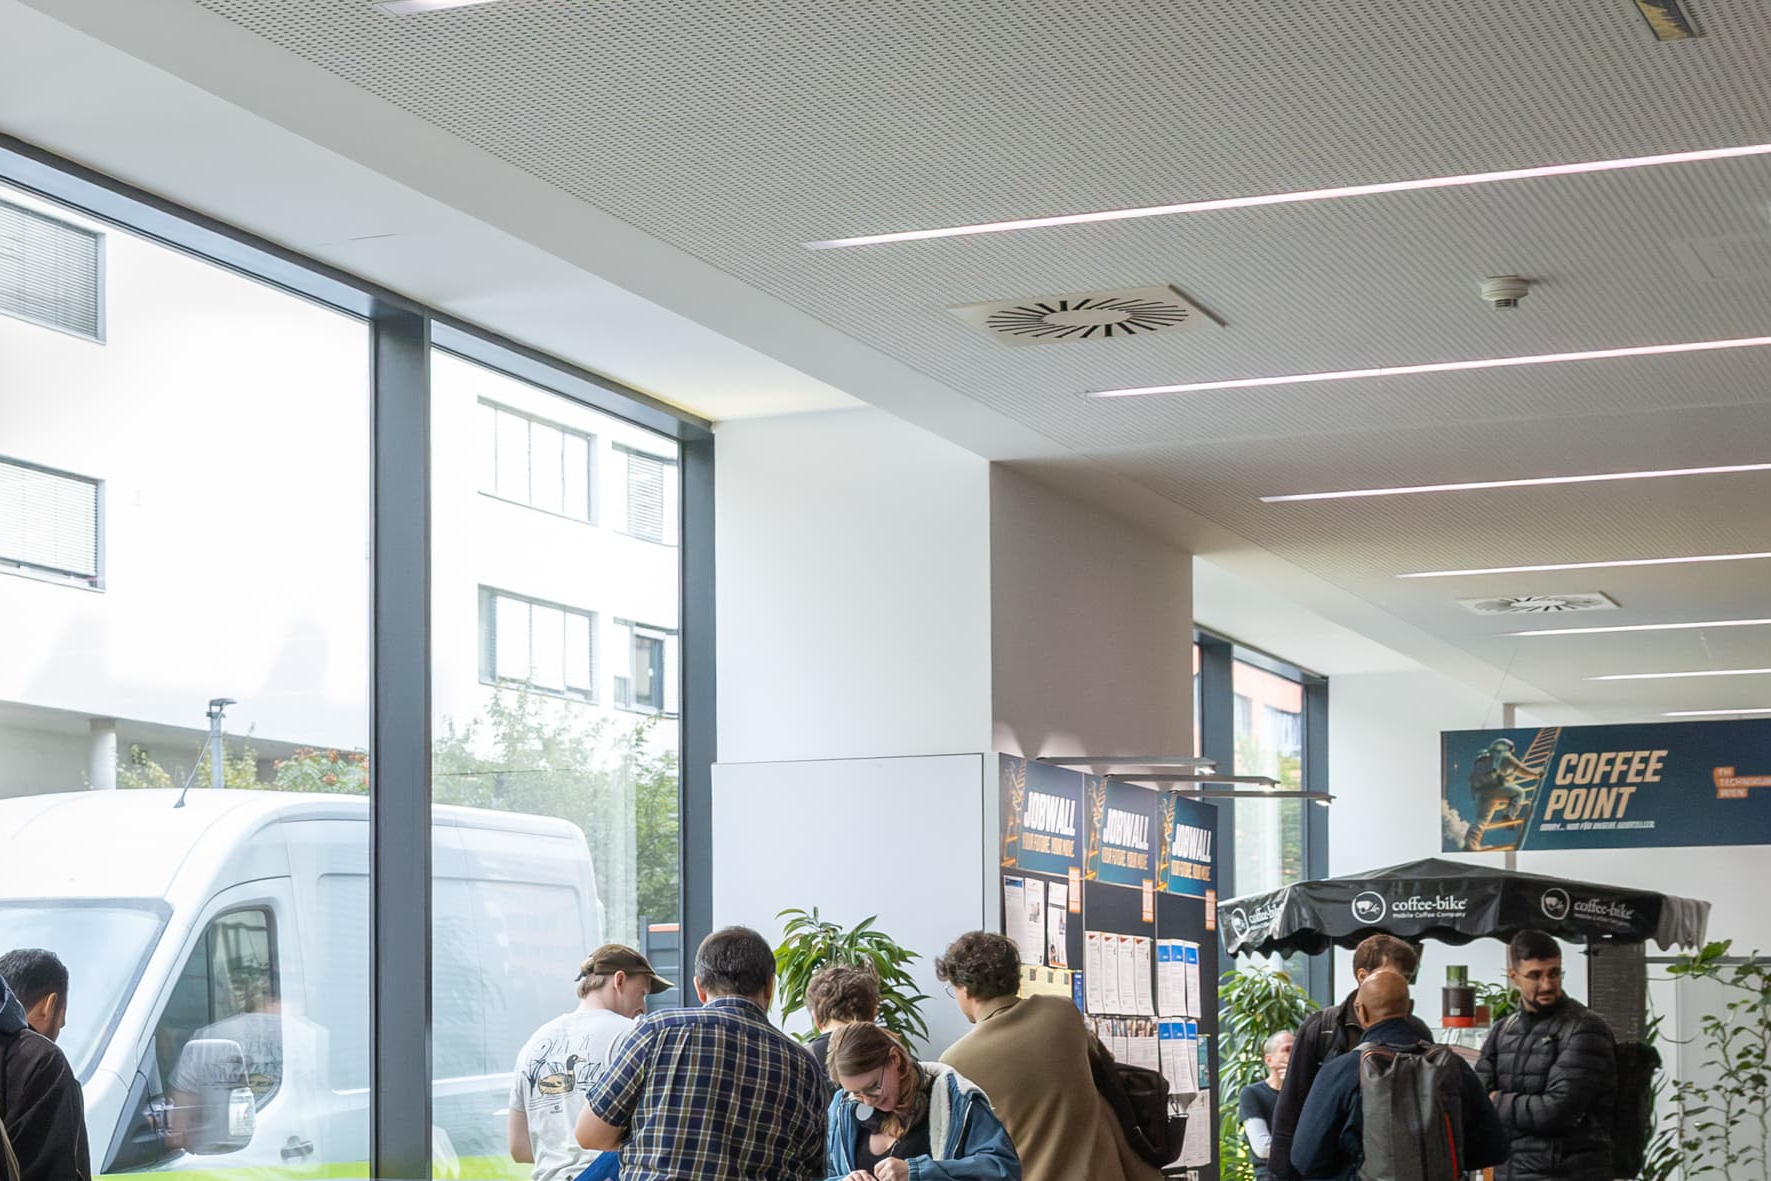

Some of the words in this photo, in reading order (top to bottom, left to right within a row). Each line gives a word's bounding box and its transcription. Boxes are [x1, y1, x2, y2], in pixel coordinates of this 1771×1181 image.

[1555, 750, 1668, 786] COFFEE
[1024, 792, 1076, 836] JOBWALL
[1543, 786, 1636, 820] POINT
[1103, 808, 1149, 850] JOBWALL
[1172, 823, 1212, 863] JOBWALL
[1392, 894, 1468, 911] coffee-bike
